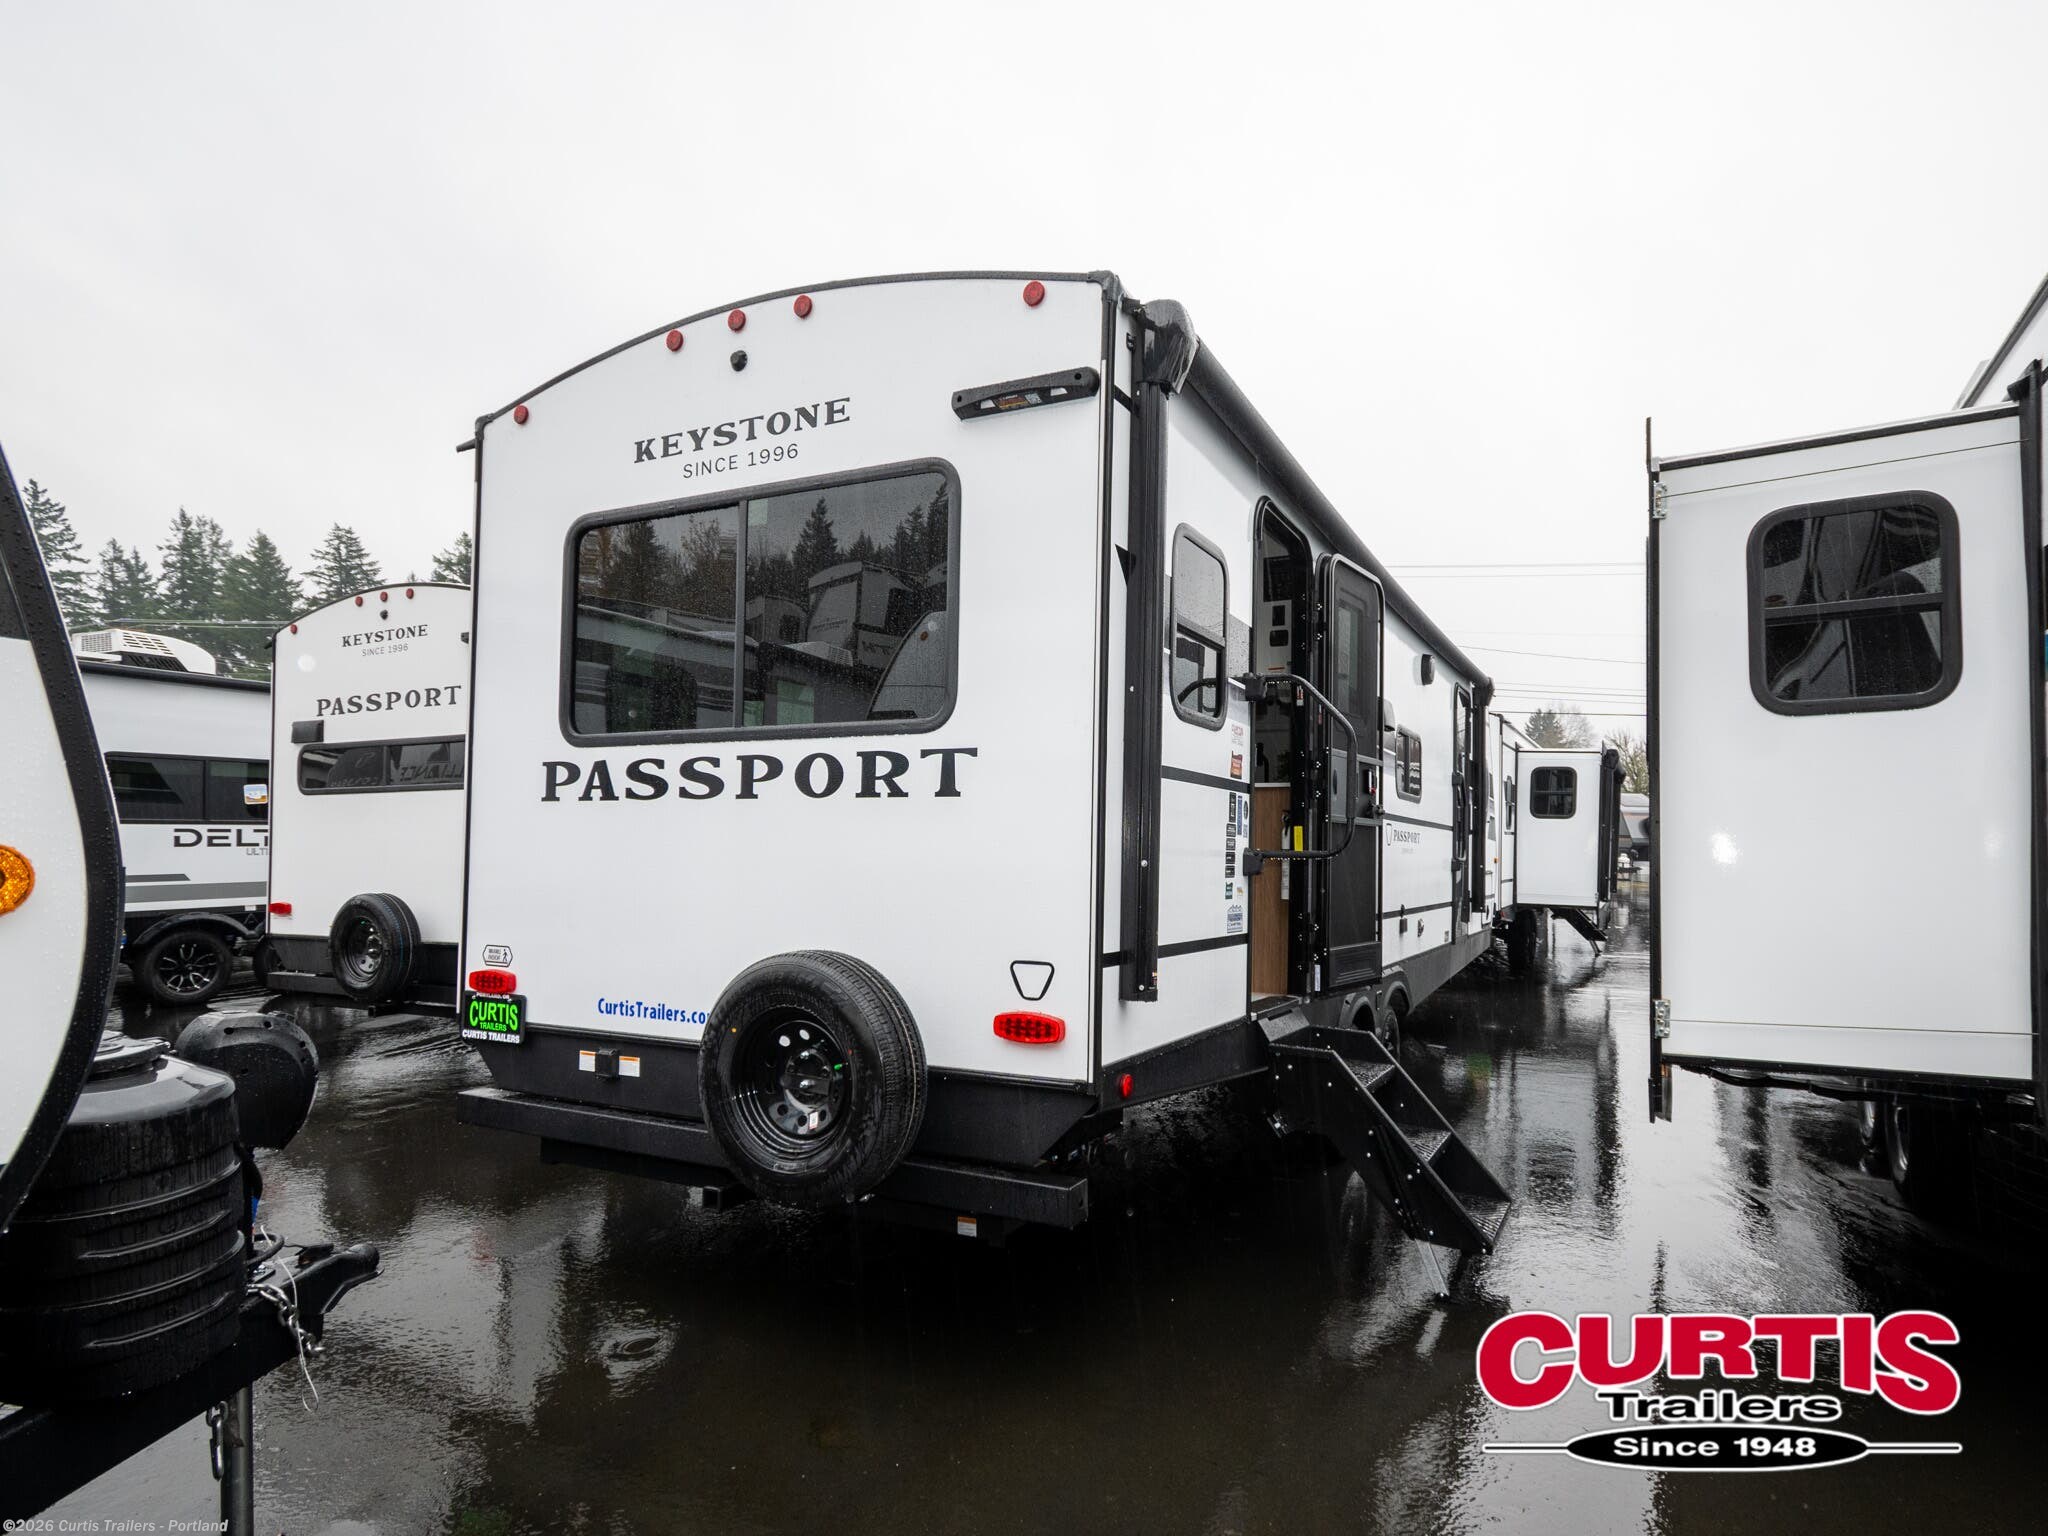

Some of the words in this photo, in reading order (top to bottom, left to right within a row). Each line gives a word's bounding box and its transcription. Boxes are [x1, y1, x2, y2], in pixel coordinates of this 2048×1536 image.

[633, 397, 850, 464] KEYSTONE
[683, 455, 738, 478] SINCE
[747, 443, 799, 467] 1996
[342, 624, 428, 648] KEYSTONE
[362, 646, 385, 656] SINCE
[388, 643, 409, 653] 1996
[316, 685, 462, 717] PASSPORT
[541, 747, 978, 802] PASSPORT
[469, 1000, 518, 1031] CURTIS
[597, 997, 710, 1025] CurtisTrailers.co
[462, 1029, 487, 1040] CURTIS
[488, 1032, 520, 1044] TRAILERS
[480, 1021, 508, 1033] TRAILERS
